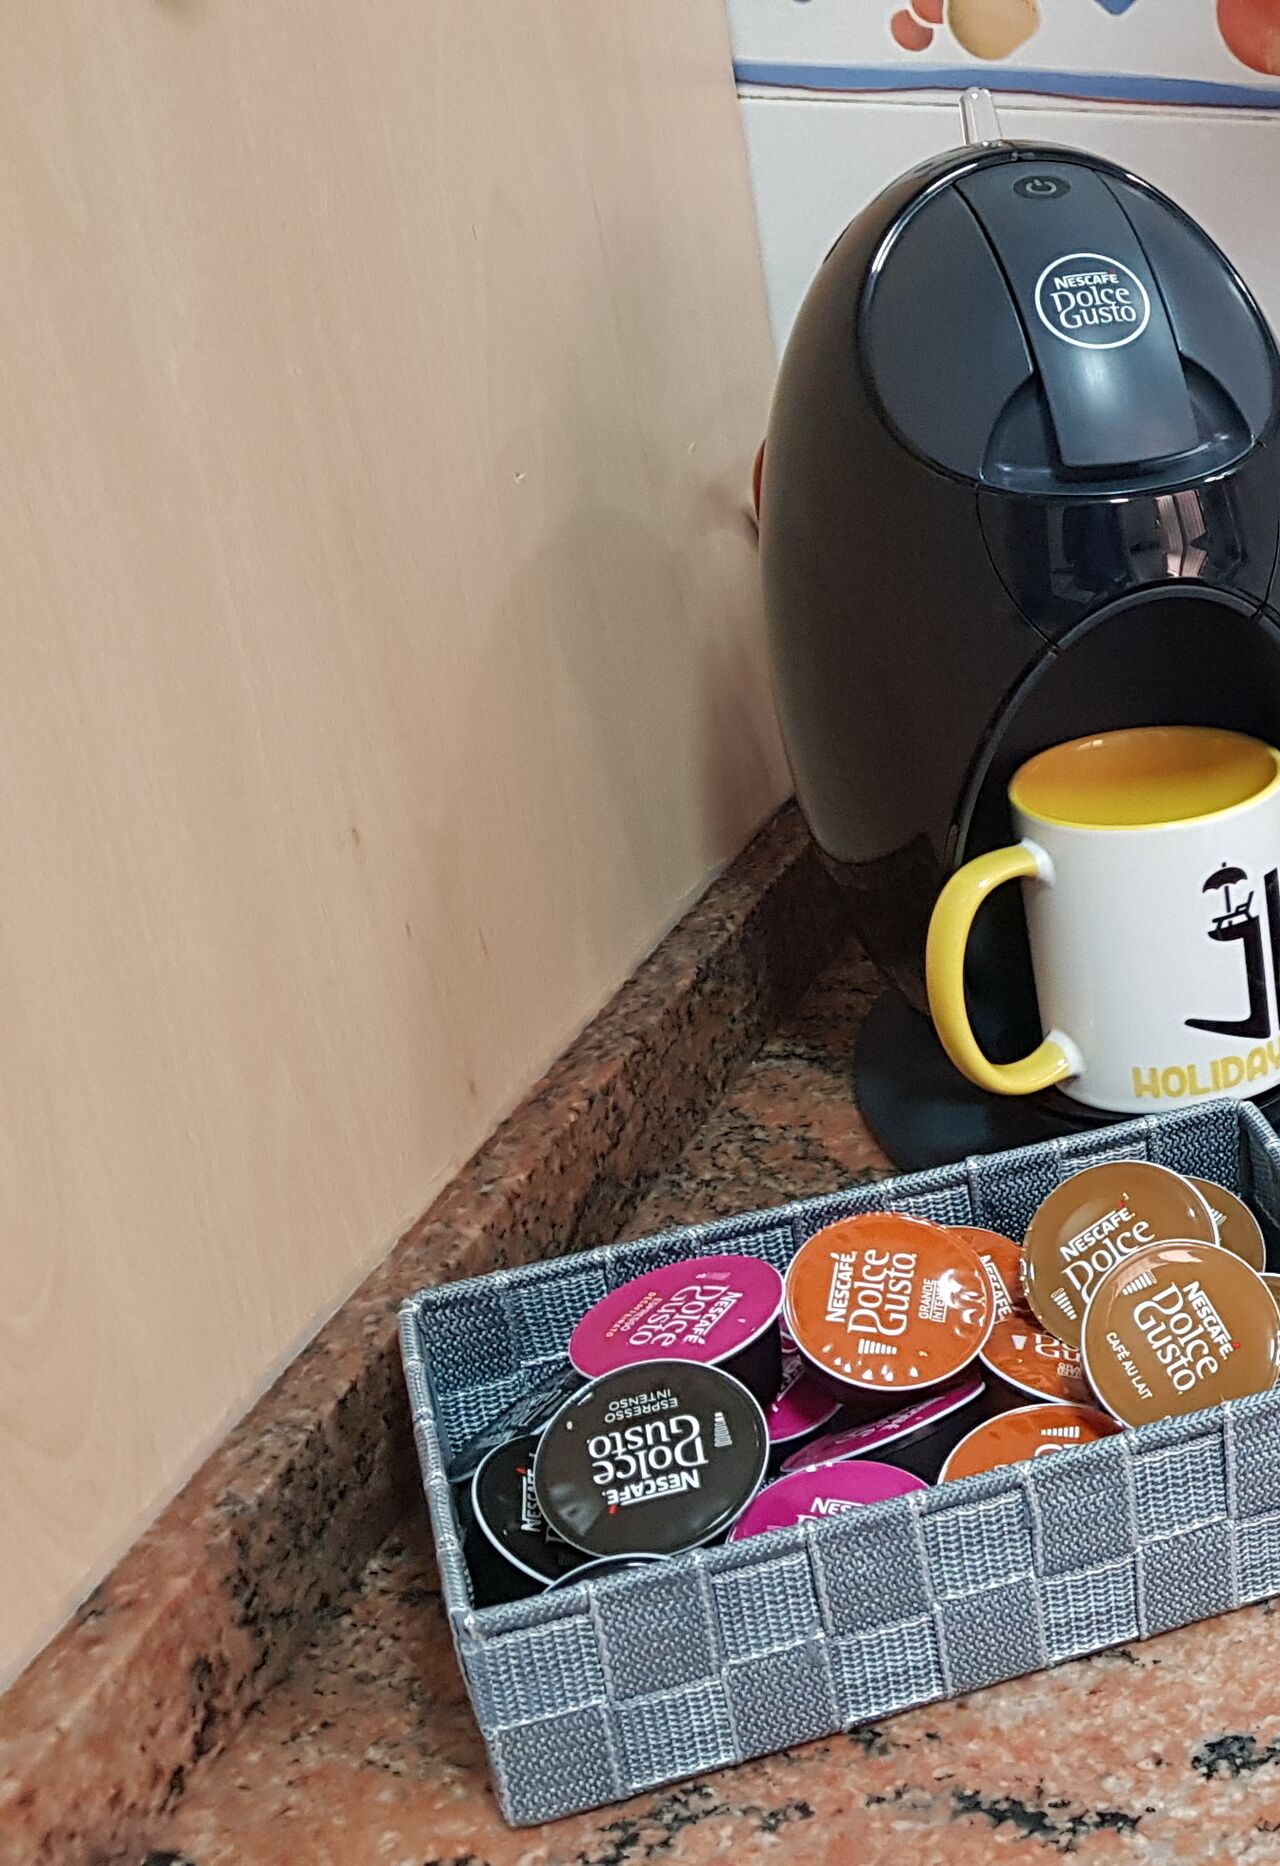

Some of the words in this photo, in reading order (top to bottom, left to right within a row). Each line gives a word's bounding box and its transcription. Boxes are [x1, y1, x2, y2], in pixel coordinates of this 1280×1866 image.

[1050, 286, 1132, 313] Dolce
[1059, 302, 1137, 329] Gusto
[1062, 1221, 1155, 1293] Dolce
[628, 1285, 702, 1346] Gusto
[650, 1285, 731, 1347] Dolce
[847, 1249, 890, 1334] Dolce
[877, 1252, 918, 1336] Gusto
[918, 1278, 935, 1320] GRANDE
[1133, 1300, 1197, 1393] Gusto
[1152, 1282, 1219, 1380] Dolce
[1106, 1331, 1131, 1361] CAFÉ
[1121, 1360, 1139, 1378] AU
[1131, 1373, 1153, 1400] LAIT
[604, 1396, 679, 1424] ESPRESSO
[608, 1388, 672, 1412] INTENSO
[587, 1414, 701, 1460] Gusto
[591, 1436, 710, 1485] Dolce
